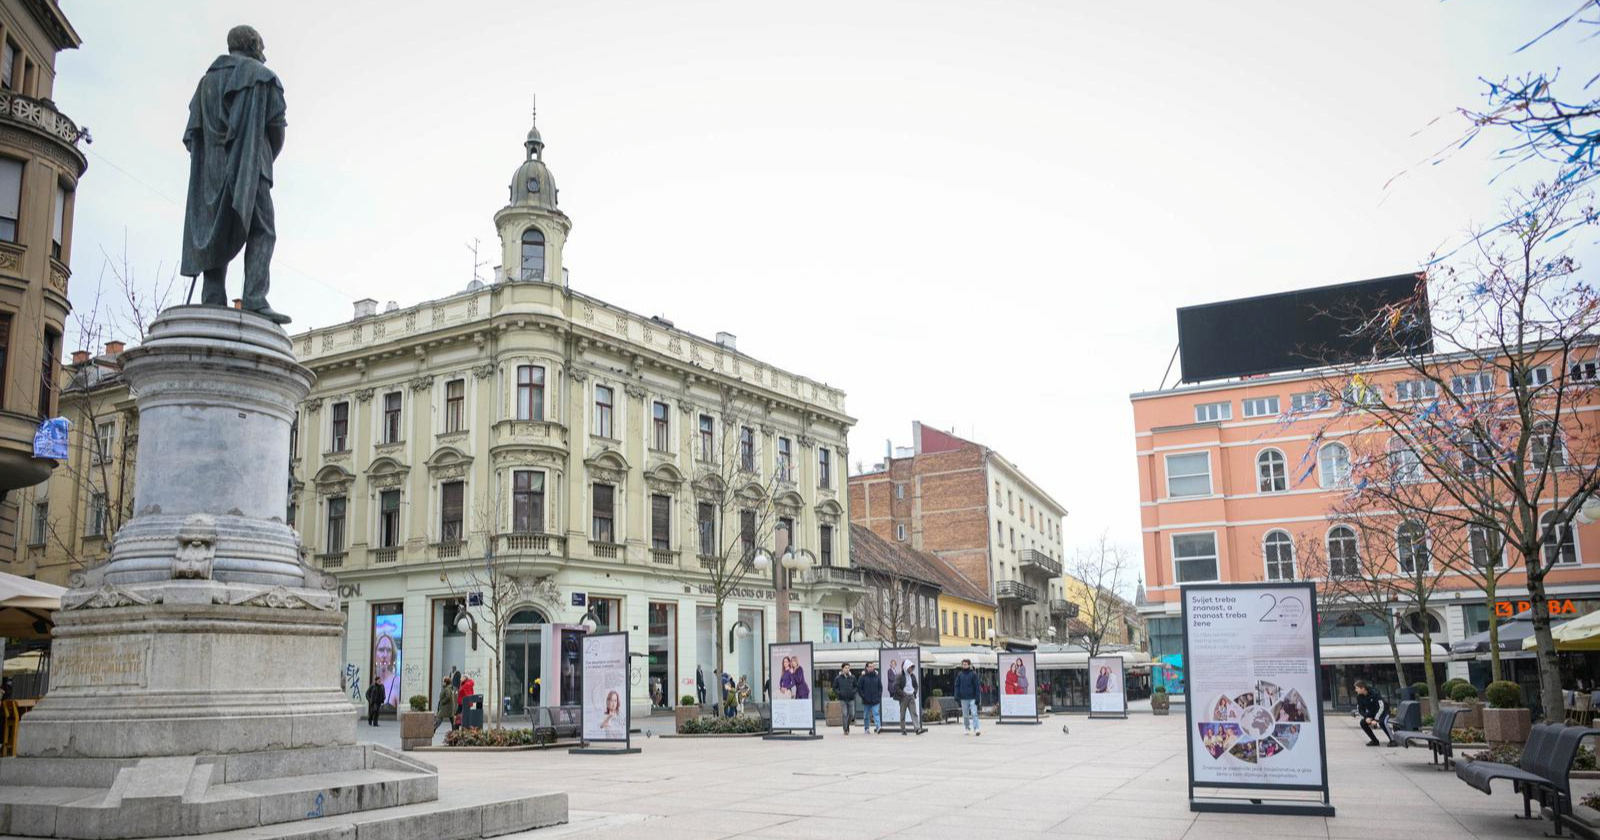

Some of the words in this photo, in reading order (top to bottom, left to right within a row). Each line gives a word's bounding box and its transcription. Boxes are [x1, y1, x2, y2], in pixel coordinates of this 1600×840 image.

[699, 584, 726, 597] UNIT
[1192, 596, 1214, 604] Svijet
[1518, 598, 1577, 615] PBA
